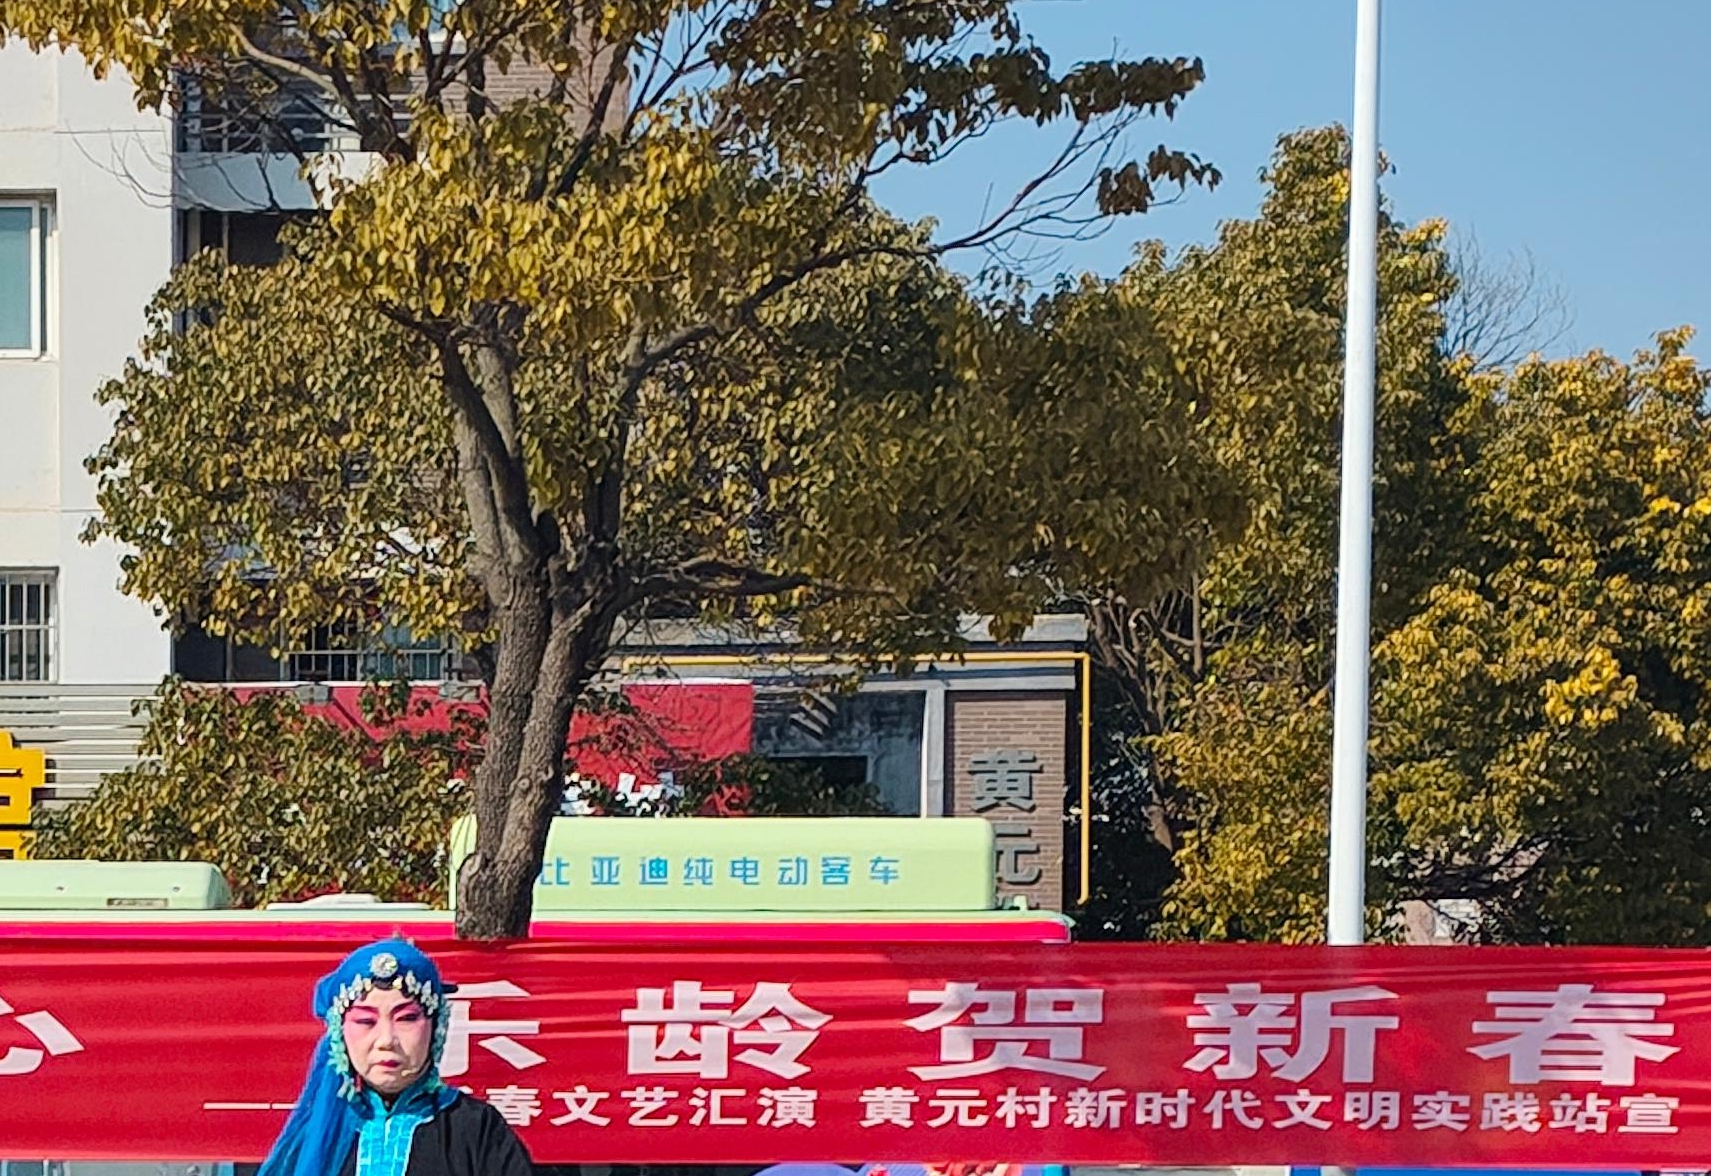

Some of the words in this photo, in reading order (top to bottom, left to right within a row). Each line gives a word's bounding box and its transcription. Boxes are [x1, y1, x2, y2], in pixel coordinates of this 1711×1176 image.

[970, 750, 1044, 910] 黄元
[539, 856, 901, 886] 比亚迪纯电动客车
[858, 1086, 1680, 1134] 黄元村新时代文明实践站宣
